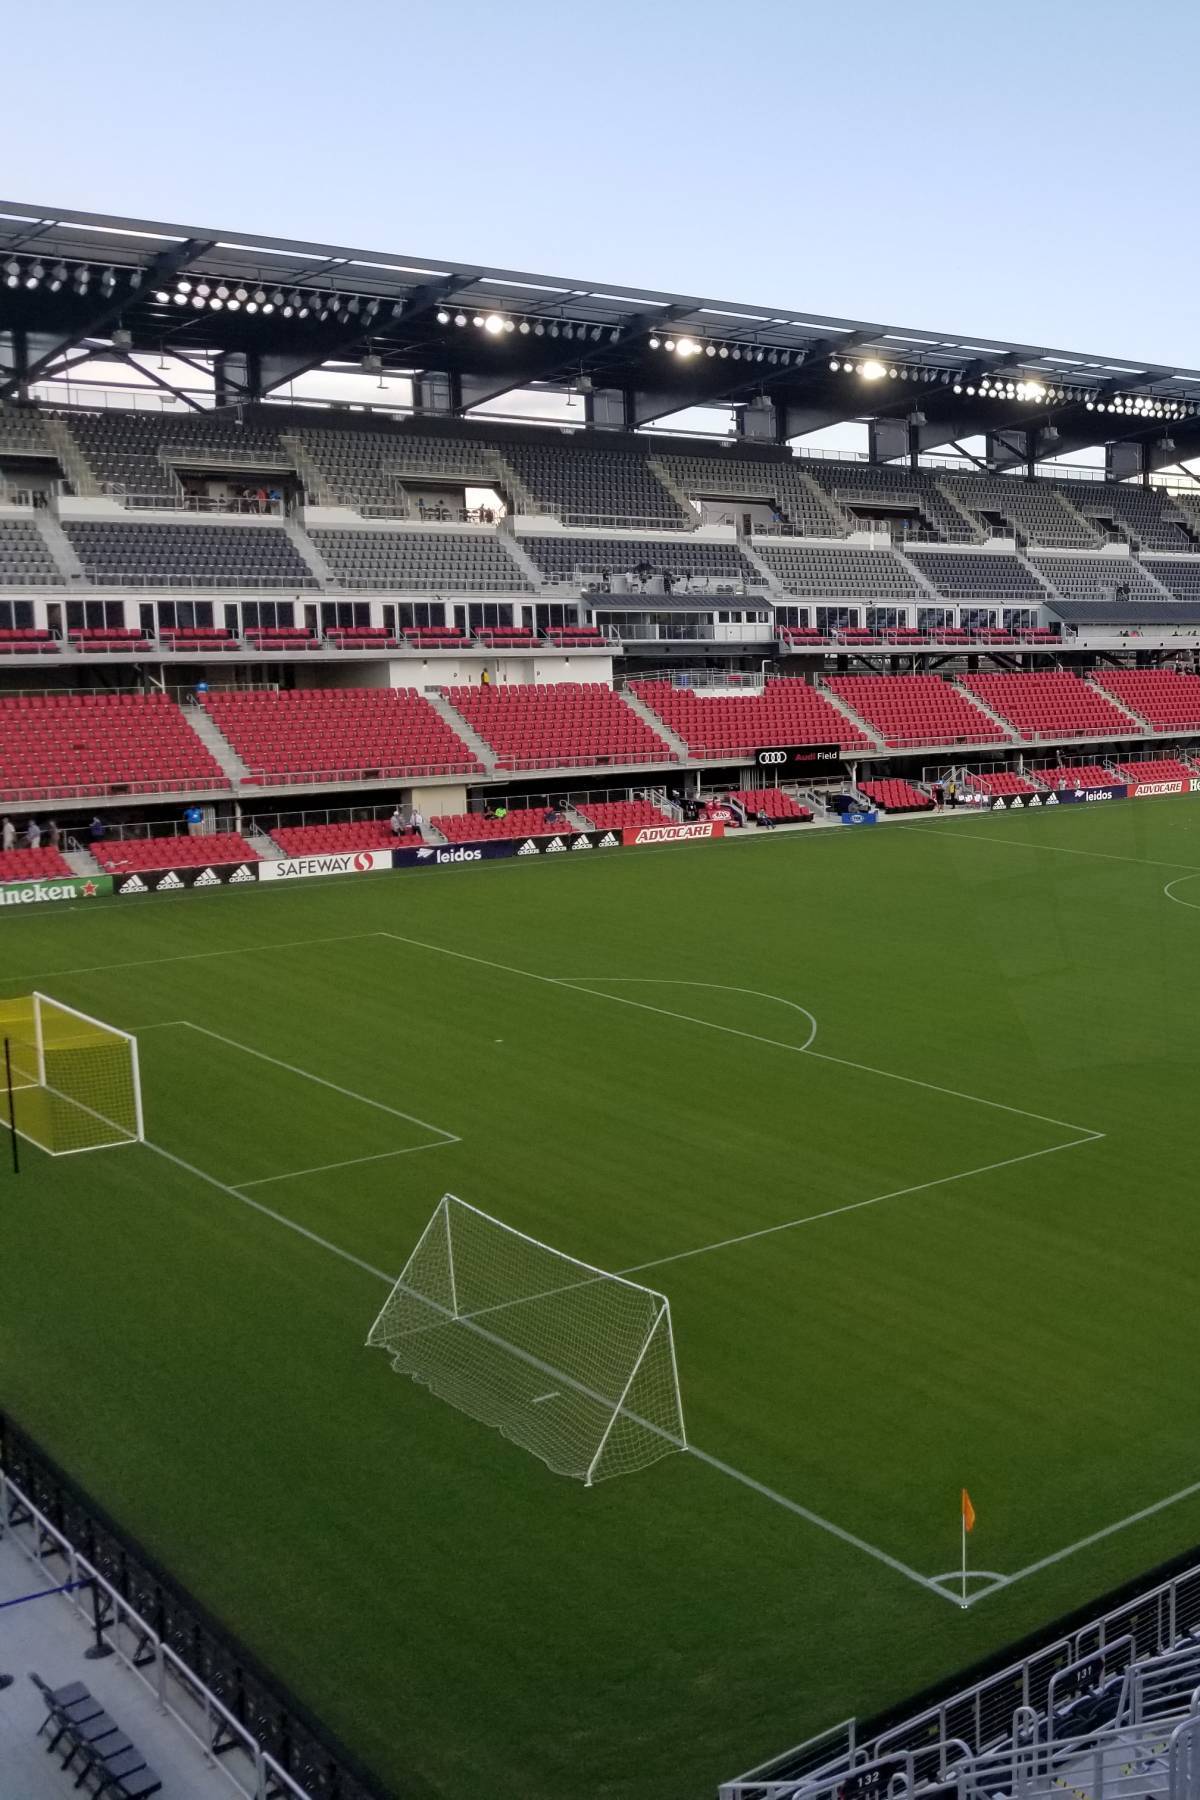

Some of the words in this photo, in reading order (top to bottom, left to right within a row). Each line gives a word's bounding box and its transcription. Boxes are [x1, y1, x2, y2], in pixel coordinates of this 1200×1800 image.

[795, 753, 816, 761] Audi
[817, 752, 837, 760] Field
[1086, 790, 1112, 801] leidos
[1136, 781, 1182, 796] ADVOCARE
[636, 823, 713, 844] ADVOCARE
[436, 848, 482, 864] leidos
[276, 856, 351, 877] SAFEWAY
[119, 885, 148, 894] adidas
[156, 882, 185, 890] adidas
[193, 879, 222, 887] adidas
[229, 875, 256, 883] adidas
[1077, 1665, 1092, 1681] 131
[857, 1771, 880, 1788] 132
